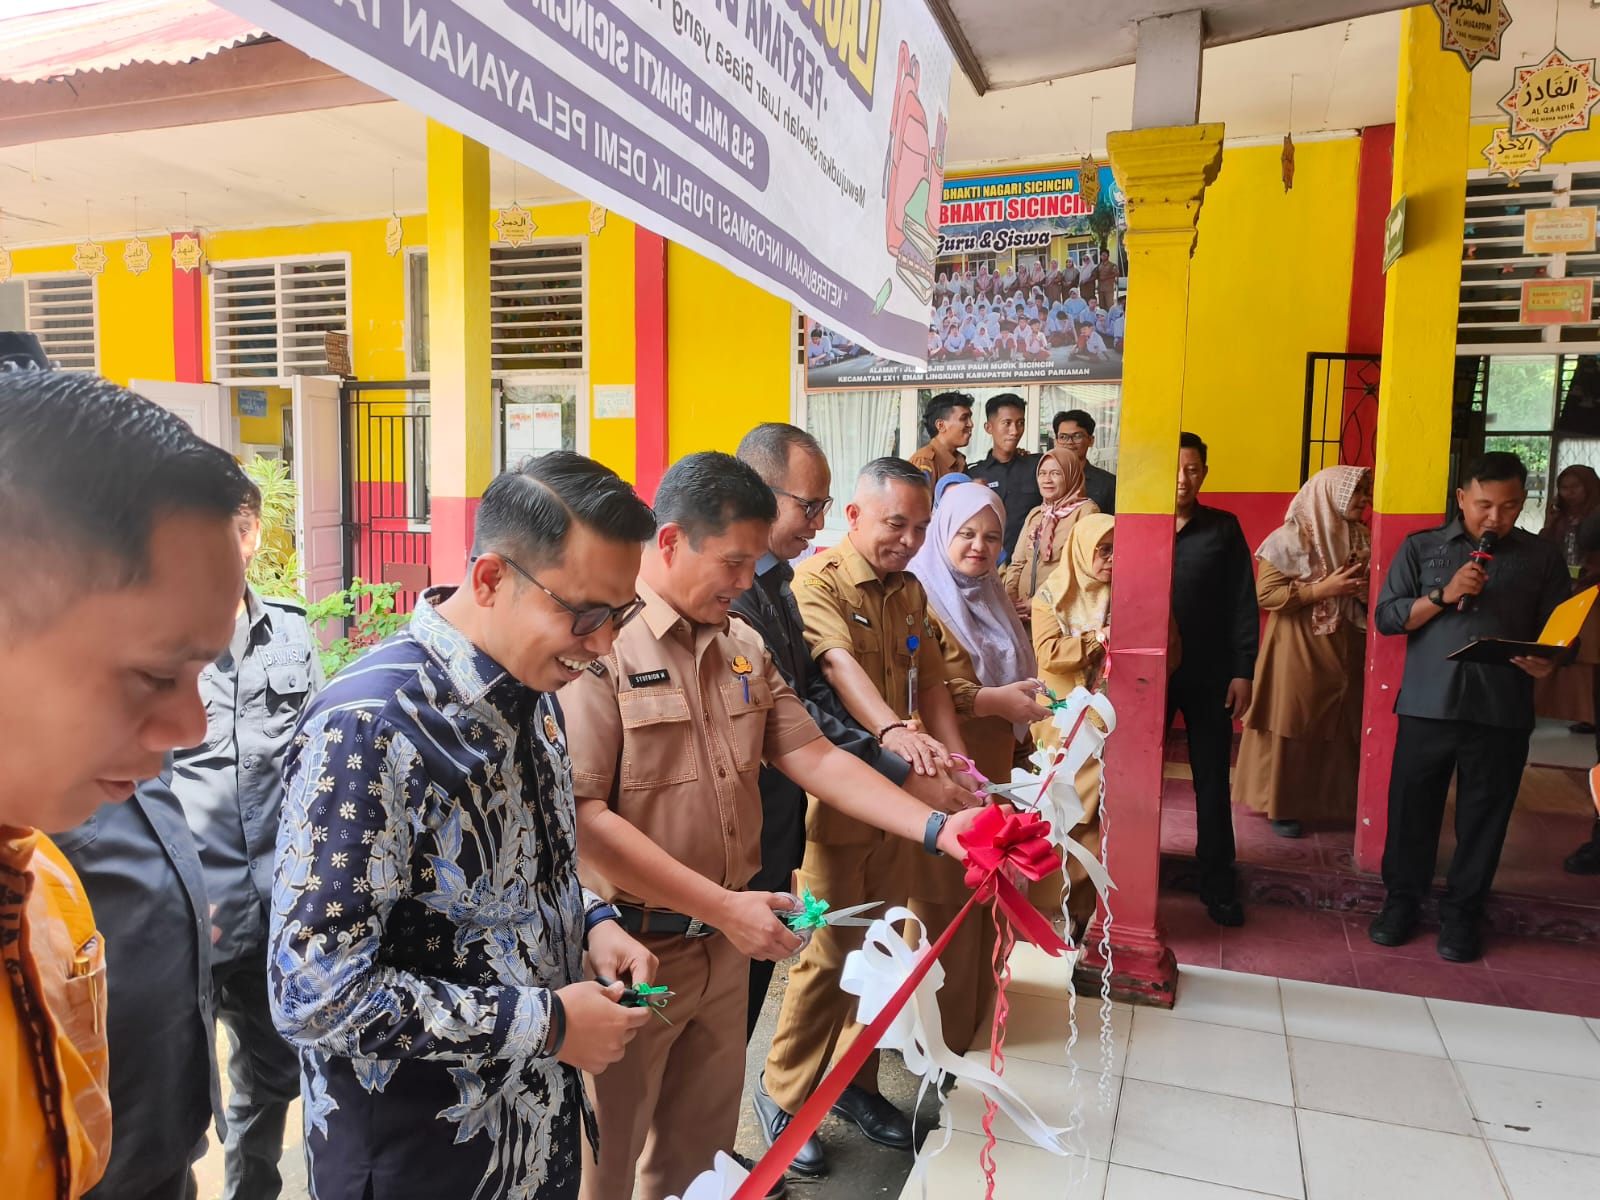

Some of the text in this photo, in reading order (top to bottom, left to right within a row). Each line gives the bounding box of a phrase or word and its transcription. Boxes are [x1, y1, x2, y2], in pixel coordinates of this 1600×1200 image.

[1543, 103, 1575, 114] QAADIR
[943, 186, 981, 201] BHAKTI
[983, 182, 1022, 198] NAGARI
[1024, 178, 1073, 193] SICINCIN
[940, 200, 1003, 224] BHAKTI
[993, 230, 1050, 251] Siswa
[946, 363, 966, 371] RAYA
[990, 361, 1017, 369] MUDIK
[1018, 361, 1055, 369] SICINCIN
[838, 375, 881, 383] KECAMATAN
[925, 372, 964, 380] LINGKUNG
[966, 371, 1012, 379] KABUPATEN
[1014, 369, 1046, 377] PADANG
[1047, 368, 1090, 376] PARIAMAN
